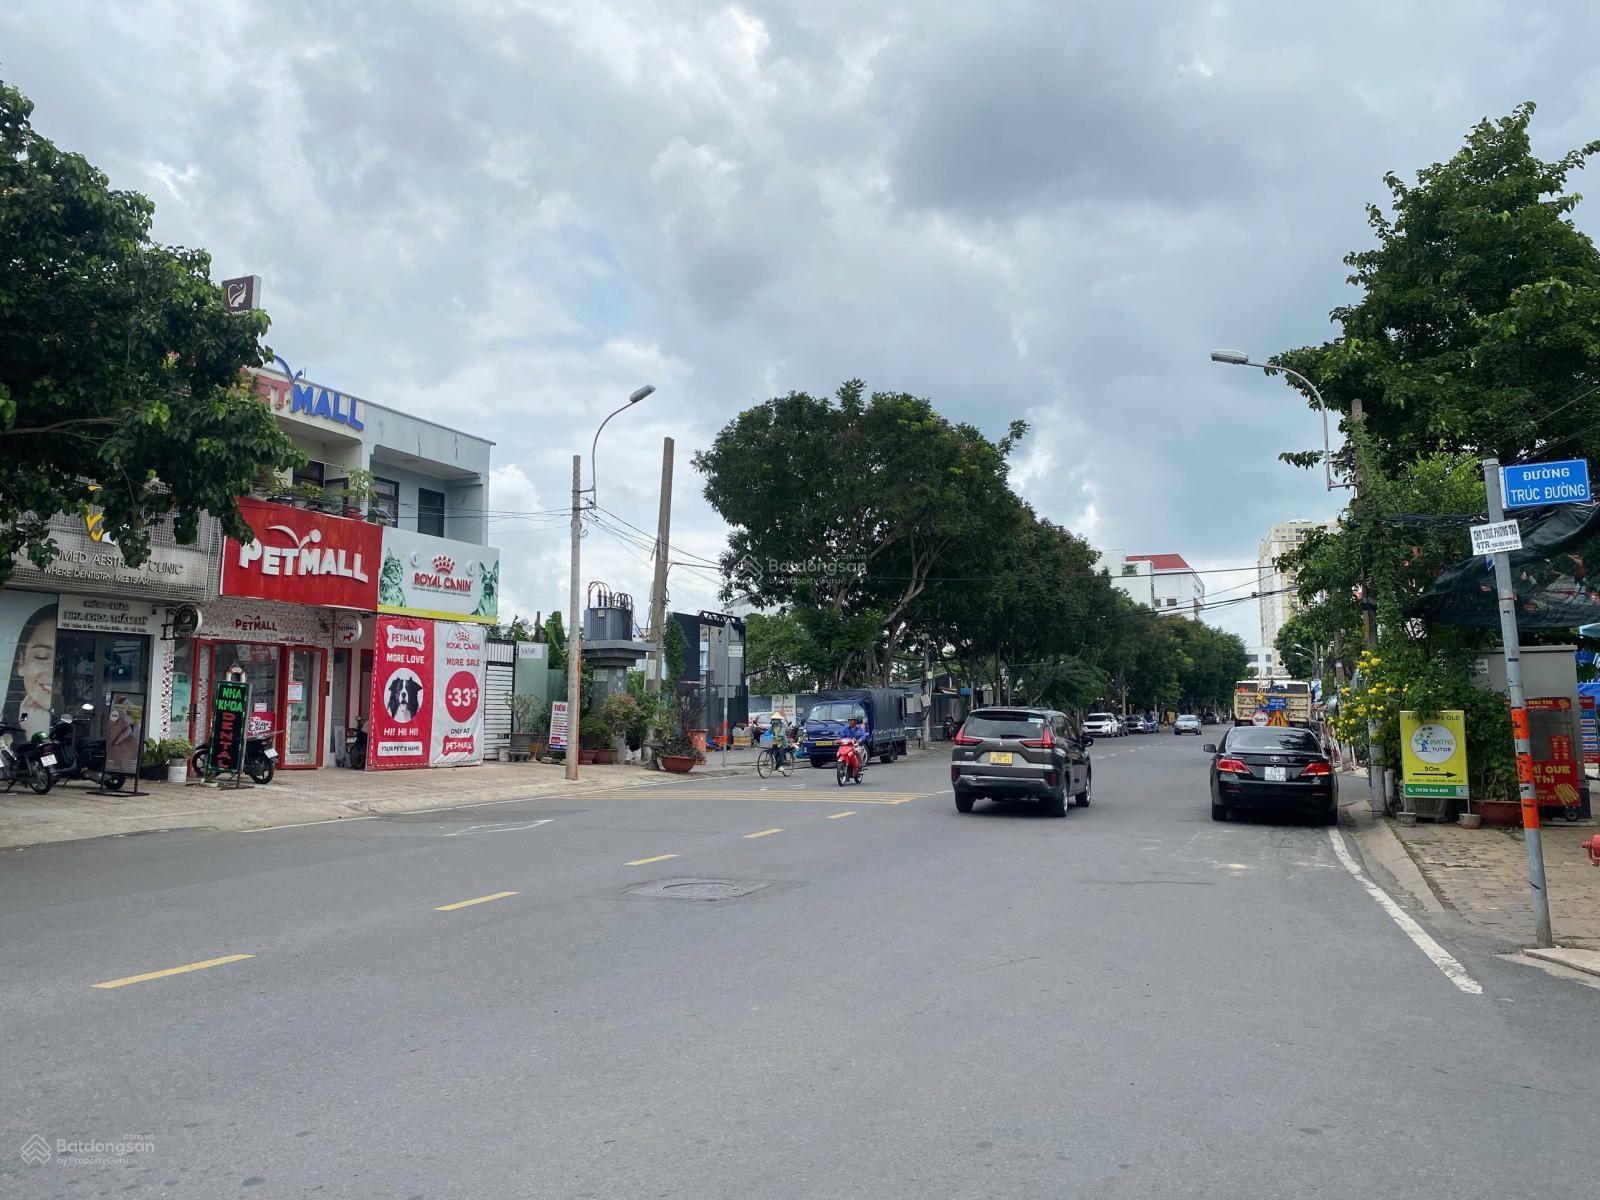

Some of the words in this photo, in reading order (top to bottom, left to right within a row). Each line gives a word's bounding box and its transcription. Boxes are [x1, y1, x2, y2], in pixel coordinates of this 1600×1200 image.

[1522, 468, 1570, 480] ĐƯỜNG
[1510, 485, 1540, 502] TRÚC
[1544, 482, 1586, 499] ĐƯỜNG
[239, 537, 369, 583] PETMALL
[149, 561, 184, 576] CLINIC
[43, 567, 72, 578] WHERE
[114, 573, 138, 584] MEETS
[413, 572, 443, 588] ROYAL
[443, 577, 472, 592] CANIN
[235, 617, 278, 631] PETMALL
[446, 642, 462, 650] ROYAL
[463, 643, 480, 651] CANIN
[386, 653, 405, 663] MORE
[406, 654, 425, 664] LOVE
[446, 658, 464, 666] MORE
[466, 658, 480, 667] SALE
[222, 688, 241, 699] NHA
[218, 700, 243, 712] KHOA
[217, 712, 236, 768] DENTAL
[1545, 765, 1571, 774] QUE
